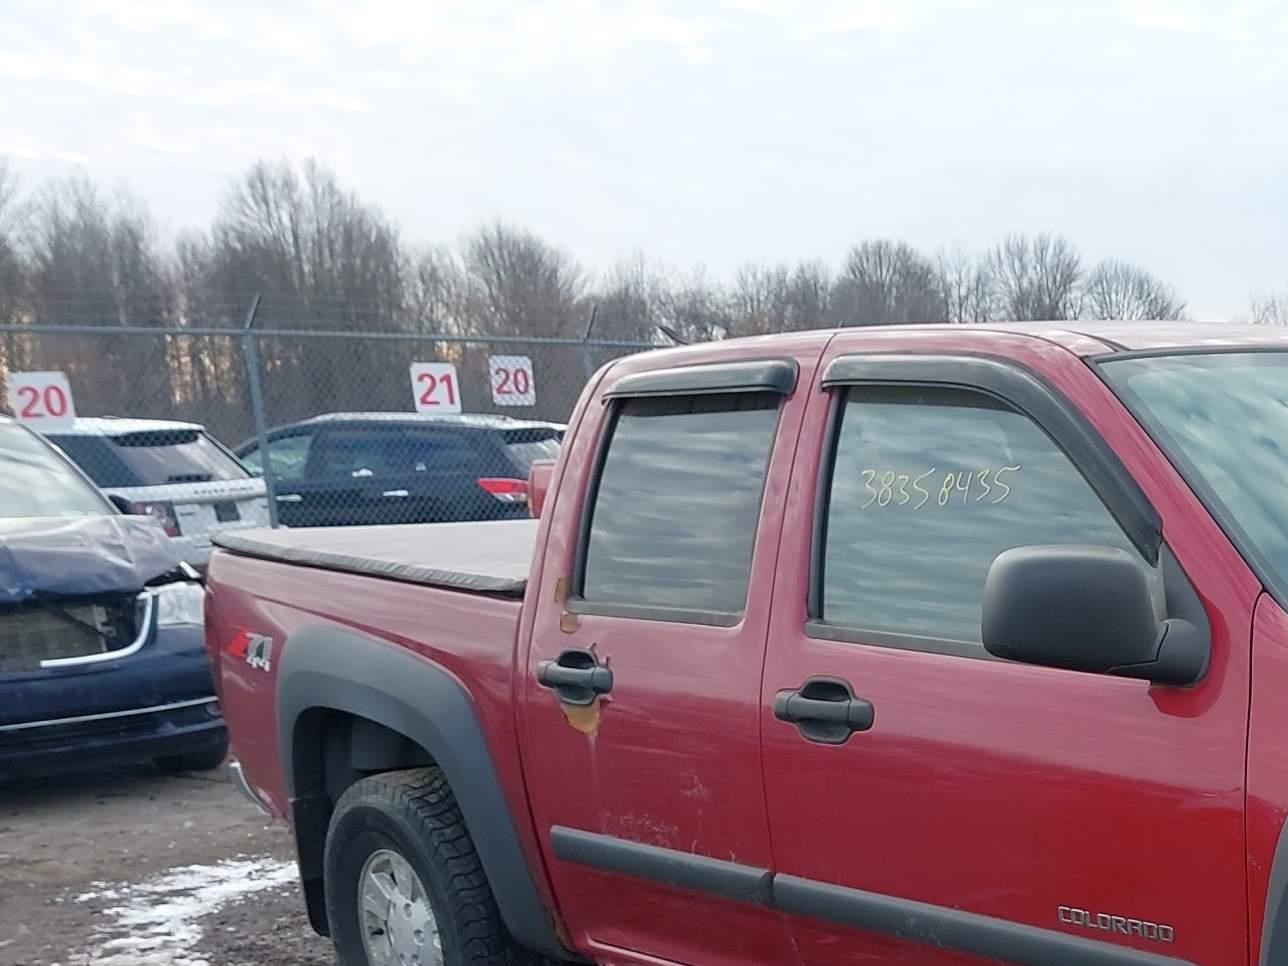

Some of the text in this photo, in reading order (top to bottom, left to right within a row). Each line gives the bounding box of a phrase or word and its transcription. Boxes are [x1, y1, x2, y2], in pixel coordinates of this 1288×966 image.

[416, 373, 456, 406] 21
[494, 367, 529, 395] 20
[16, 384, 68, 418] 20
[861, 464, 1022, 511] 38358435
[1057, 905, 1175, 943] COLORADO
